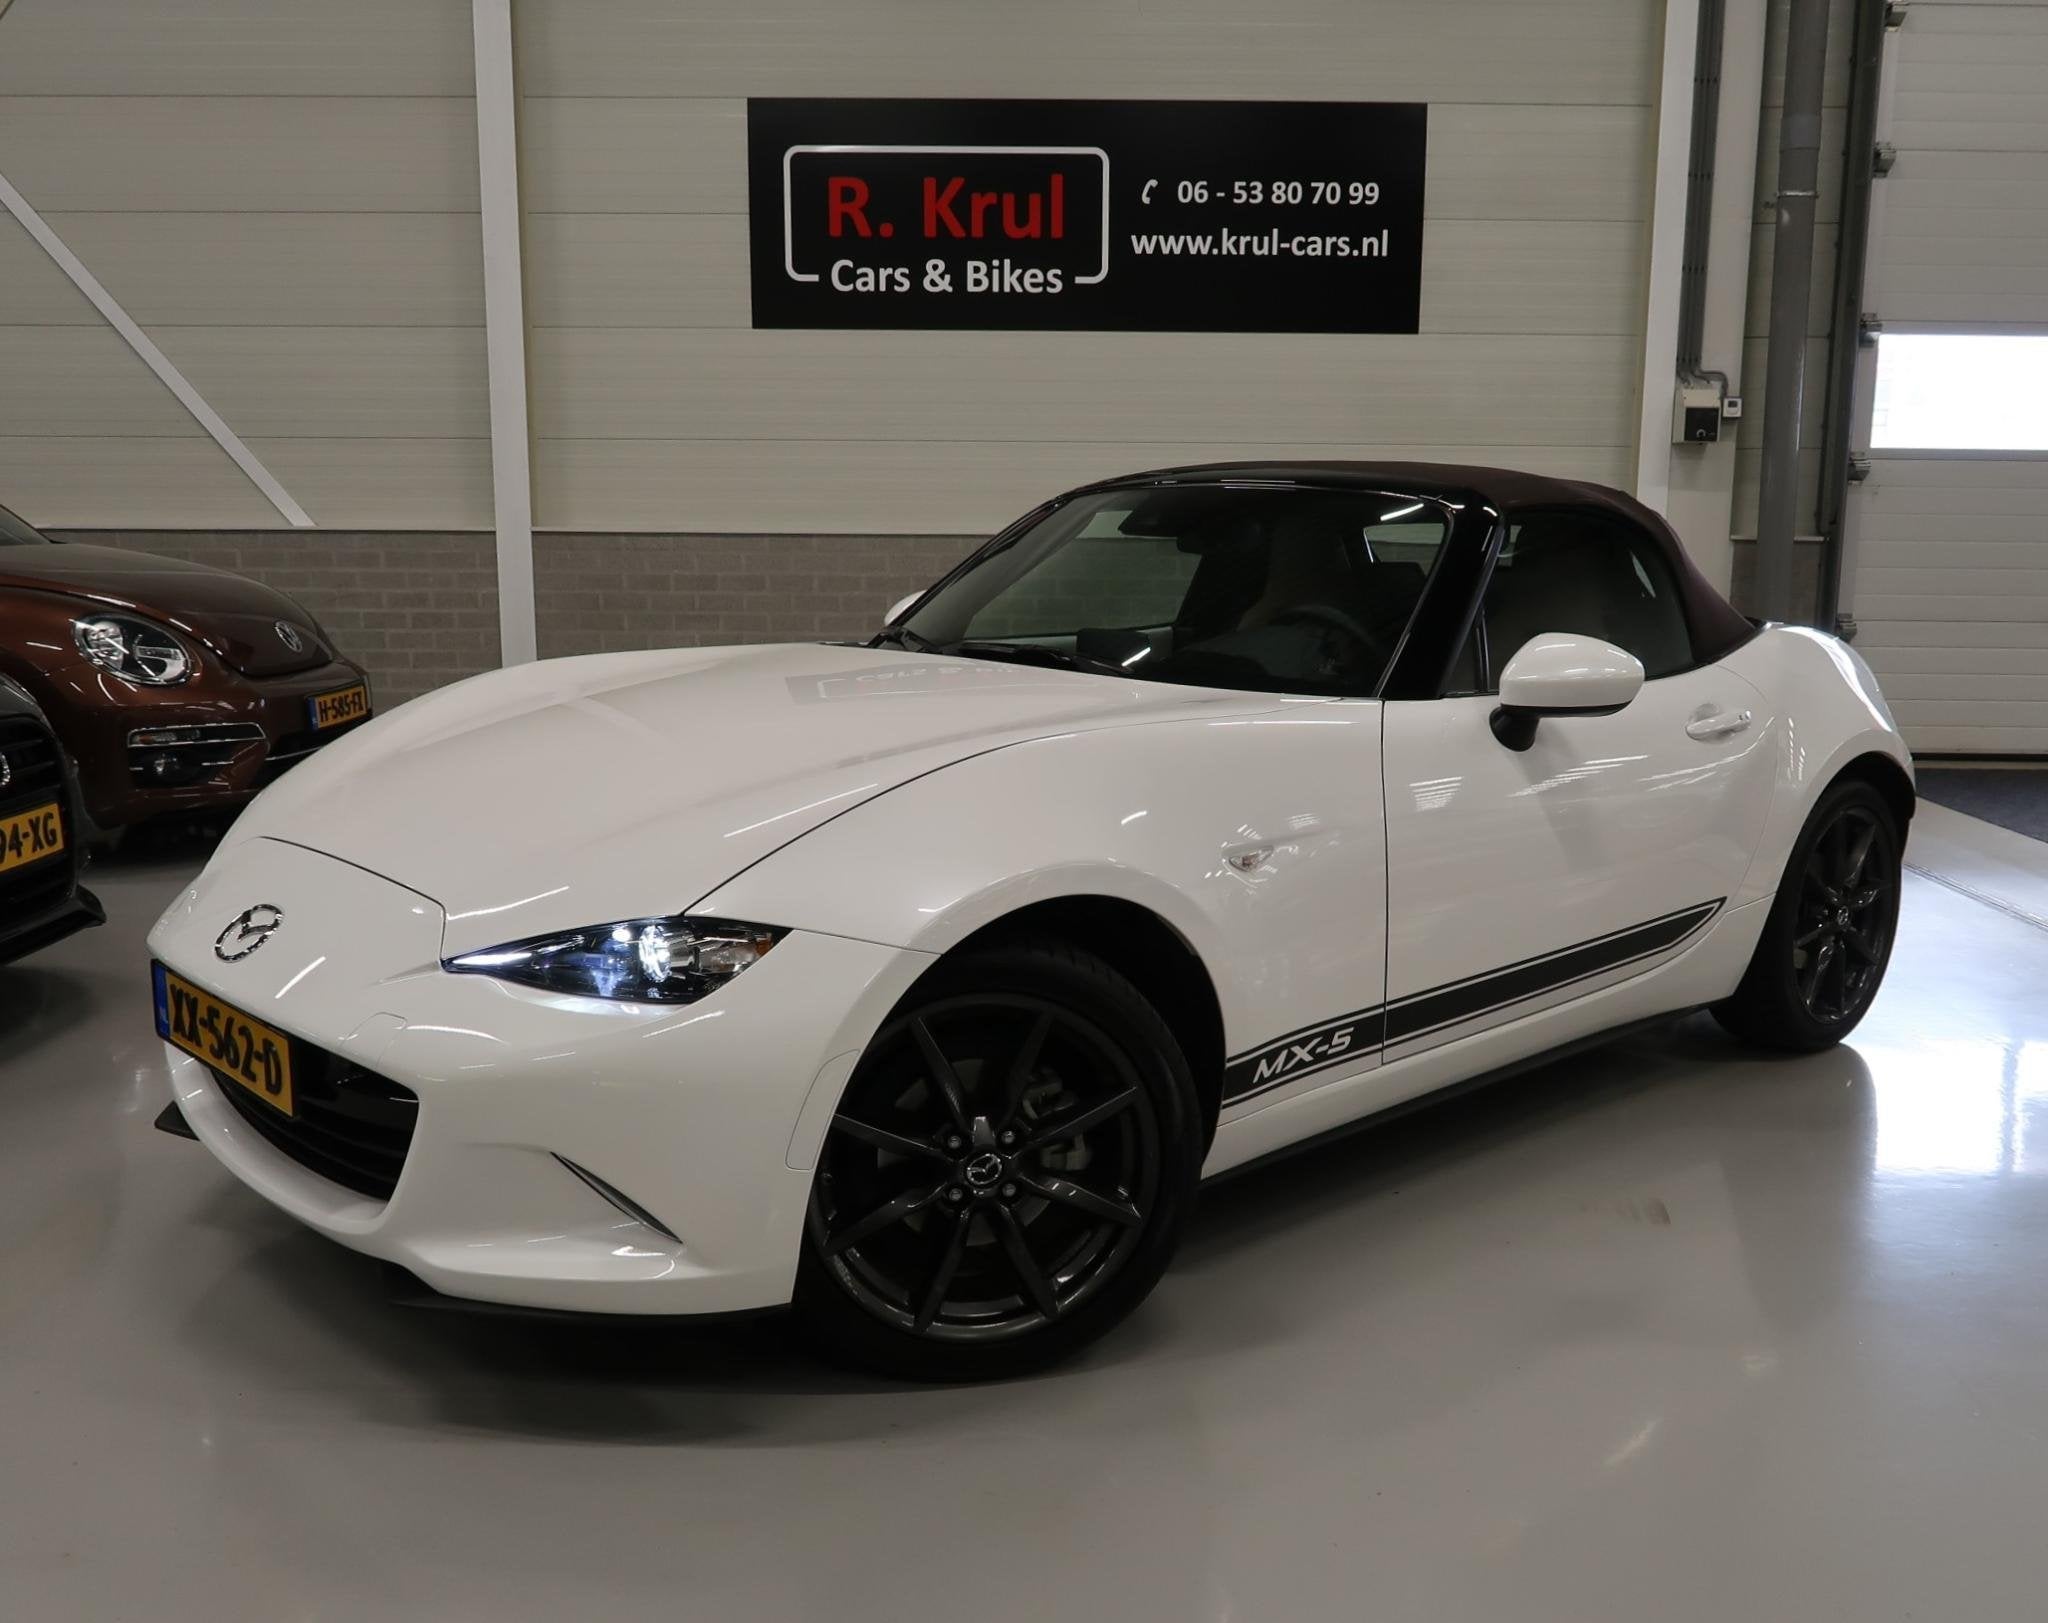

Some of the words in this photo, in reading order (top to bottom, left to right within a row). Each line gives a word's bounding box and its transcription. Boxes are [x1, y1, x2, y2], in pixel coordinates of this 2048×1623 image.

[829, 177, 894, 238] R.
[923, 174, 1064, 239] Krul
[1177, 180, 1209, 204] 06
[1232, 181, 1264, 204] 53
[1271, 181, 1303, 205] 80
[1310, 182, 1342, 205] 70
[1348, 182, 1380, 205] 99
[1131, 228, 1389, 257] www.krul-cars.nl
[830, 259, 911, 293] Cars
[922, 258, 954, 293] &
[966, 258, 1063, 294] Bikes
[169, 983, 283, 1096] XX-562-D
[1252, 1026, 1355, 1084] MX-5
